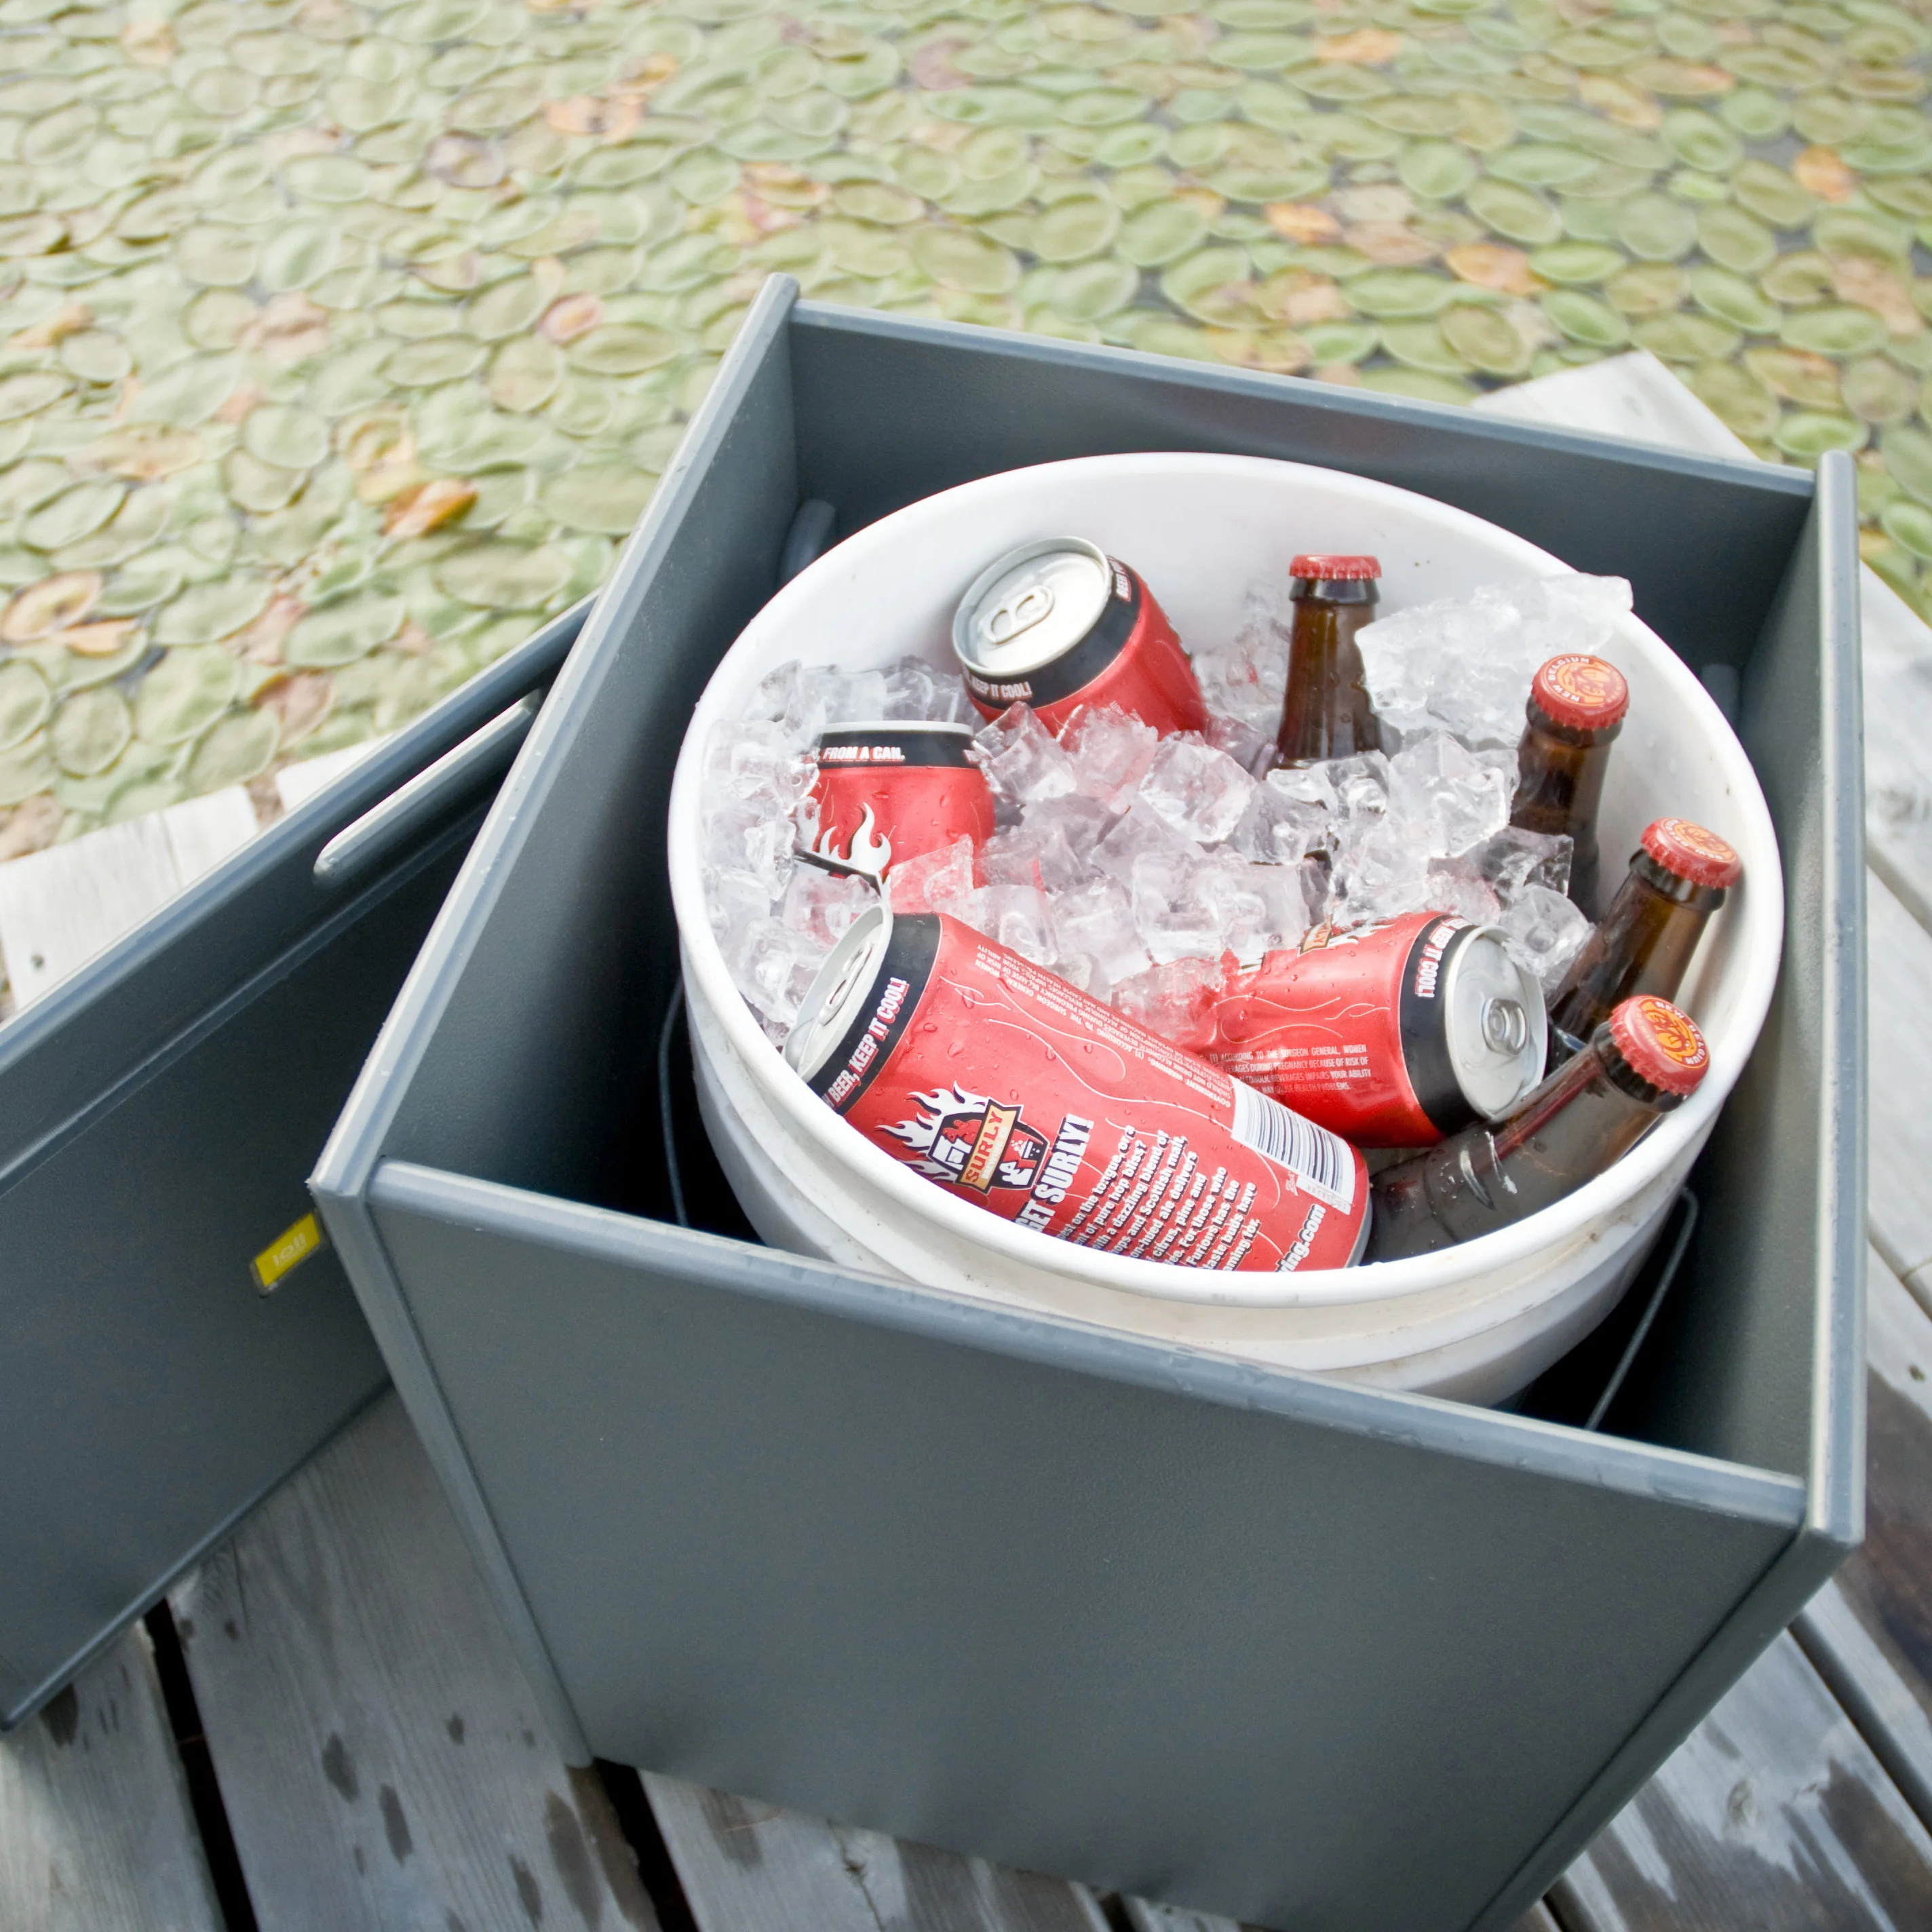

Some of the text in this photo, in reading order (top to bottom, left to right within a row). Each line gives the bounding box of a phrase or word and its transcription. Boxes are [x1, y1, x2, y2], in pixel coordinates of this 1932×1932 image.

[990, 684, 999, 697] IT
[1001, 681, 1032, 698] COOL!
[1548, 657, 1589, 702] NEW BELGIUM
[823, 746, 857, 759] FROM
[859, 746, 869, 759] A
[872, 746, 906, 760] CAN.
[1431, 926, 1456, 949] KEEP
[973, 958, 1001, 978] WOMEN
[1425, 947, 1443, 961] IT
[1417, 960, 1439, 998] COOL!
[877, 977, 907, 1020] COOL!
[869, 1018, 887, 1037] IT
[1068, 1012, 1083, 1024] THE
[1083, 1021, 1094, 1031] TO
[1655, 1001, 1705, 1064] NEW BELGIUM
[849, 1034, 877, 1073] KEEP
[1250, 1062, 1273, 1072] DURING
[1336, 1058, 1343, 1067] OF
[1345, 1057, 1359, 1066] RISK
[1360, 1056, 1368, 1066] OF
[1256, 1051, 1264, 1060] TO
[1267, 1049, 1279, 1059] THE
[1280, 1047, 1309, 1058] SURGEON
[1311, 1045, 1341, 1056] GENERAL,
[1343, 1044, 1367, 1054] WOMEN
[828, 1070, 860, 1103] BEER,
[1330, 1070, 1347, 1079] YOUR
[1348, 1068, 1370, 1078] ABILITY
[1116, 1135, 1131, 1151] or
[1123, 1123, 1136, 1136] a
[965, 1111, 1003, 1183] SURLY
[1035, 1113, 1094, 1203] SURLY!
[1085, 1223, 1098, 1234] of
[1094, 1201, 1115, 1226] pure
[1108, 1176, 1130, 1202] hop
[1119, 1138, 1148, 1178] bliss?
[1110, 1179, 1148, 1231] dazzling
[1138, 1146, 1165, 1182] blend
[1153, 1129, 1170, 1145] of
[1127, 1214, 1146, 1237] and
[1139, 1165, 1174, 1216] Scottish
[1162, 1132, 1188, 1166] malt,
[1157, 1198, 1175, 1219] ale
[1166, 1150, 1201, 1200] delivers
[1079, 1195, 1099, 1212] the
[1153, 1172, 1208, 1256] citrus, pine and
[1178, 1228, 1197, 1248] For
[1190, 1193, 1216, 1229] those
[1206, 1165, 1229, 1195] who
[1220, 1213, 1243, 1243] buds
[1234, 1181, 1258, 1212] have
[1072, 1213, 1086, 1224] on
[1186, 1178, 1241, 1264] Furious has the
[1242, 1218, 1260, 1237] for.
